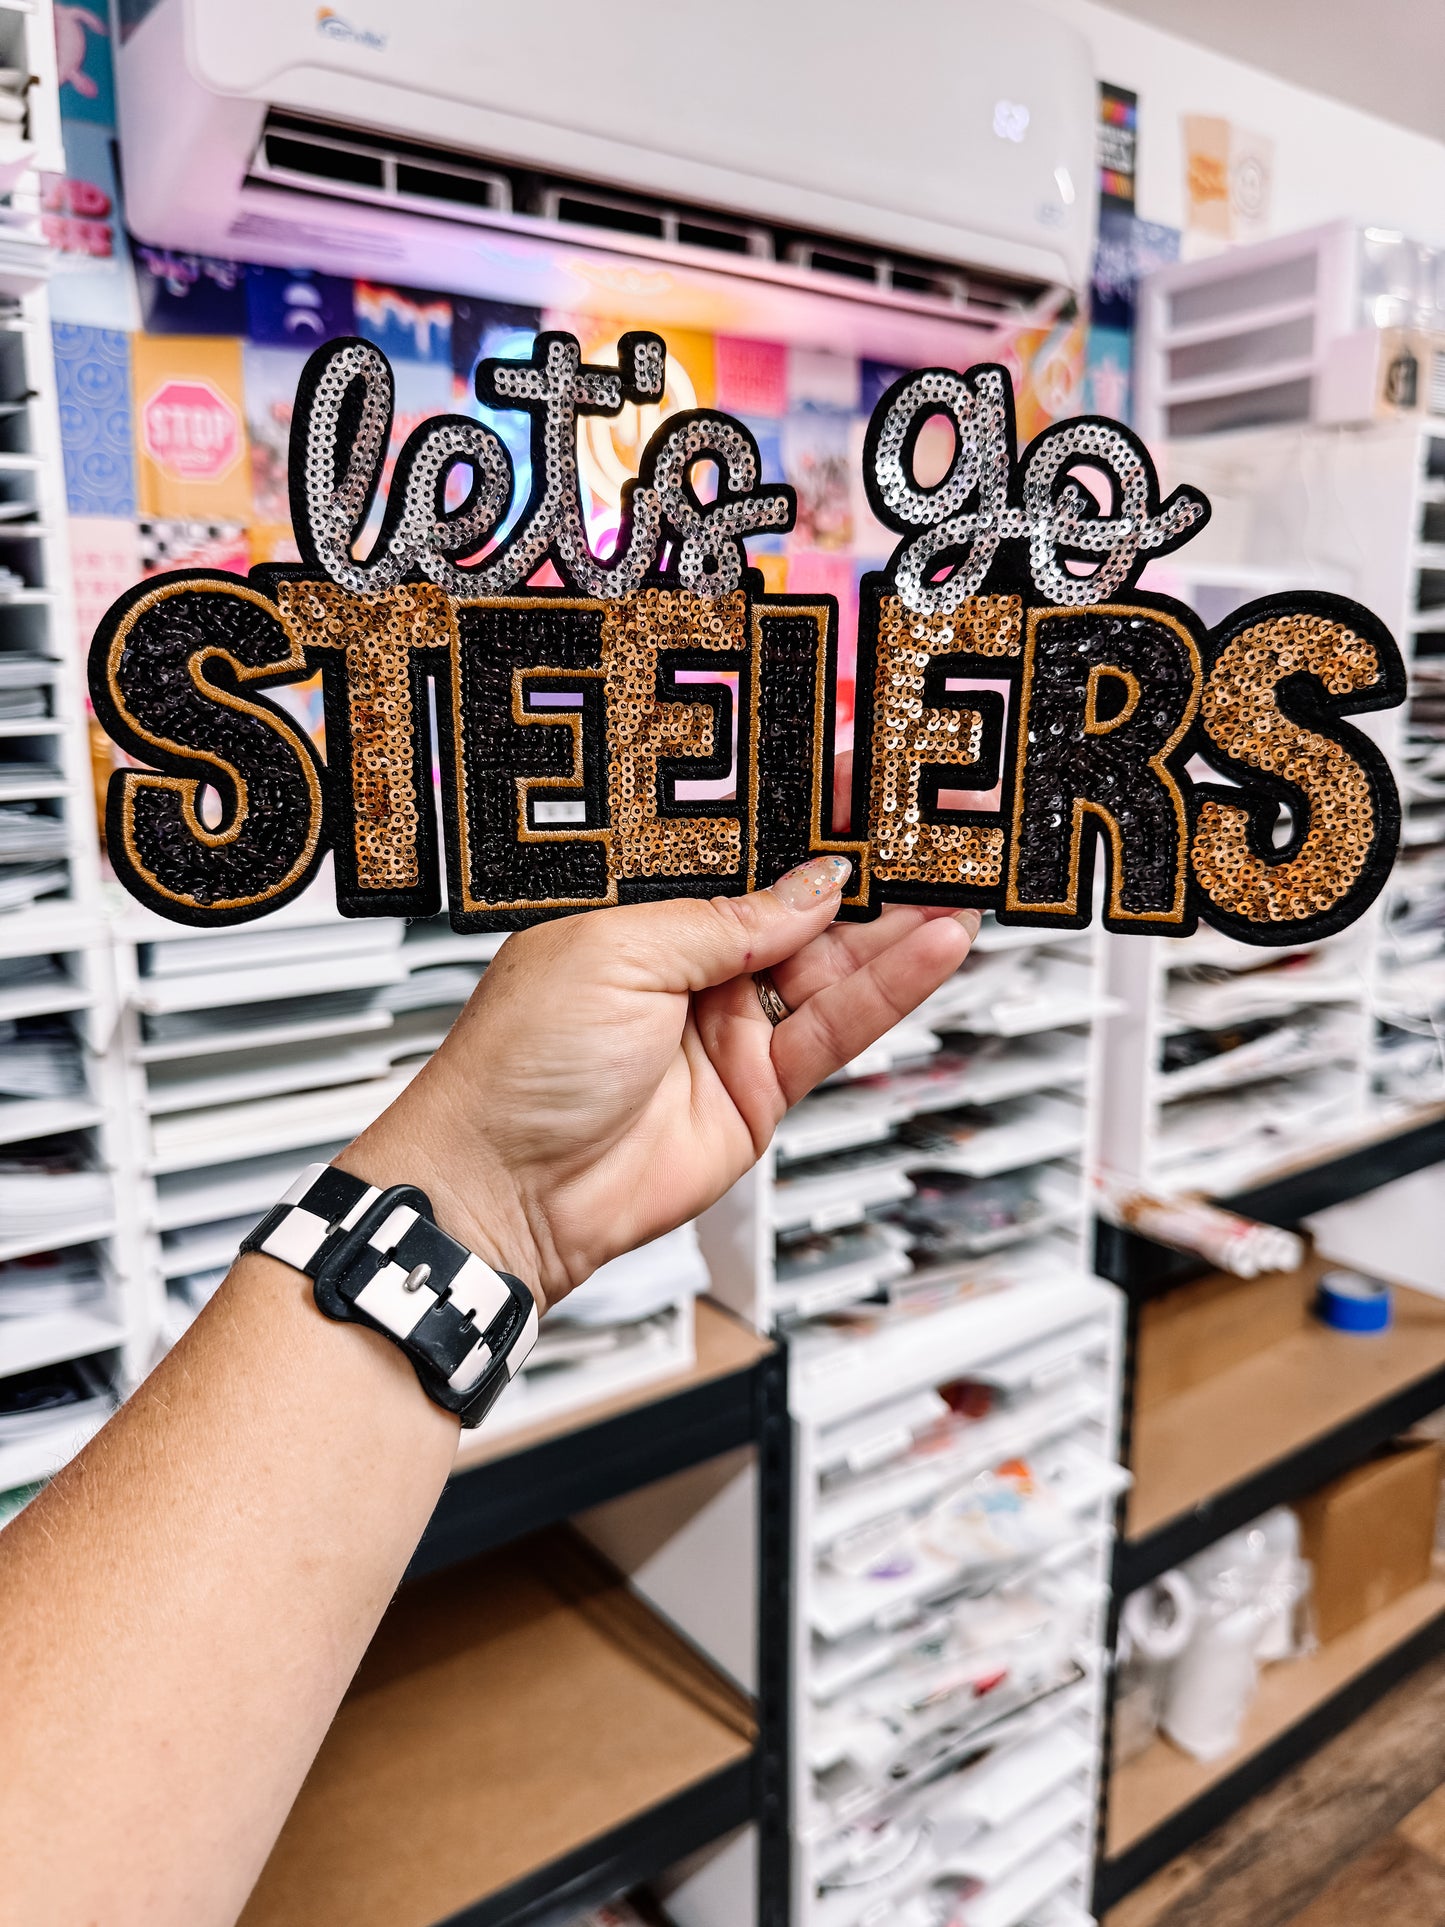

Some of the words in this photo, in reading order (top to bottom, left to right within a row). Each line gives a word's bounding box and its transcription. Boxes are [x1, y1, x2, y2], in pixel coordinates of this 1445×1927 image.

[148, 404, 234, 448] STOP
[300, 336, 792, 600] let's
[869, 367, 1206, 614] go
[103, 576, 1386, 928] STEELERS
